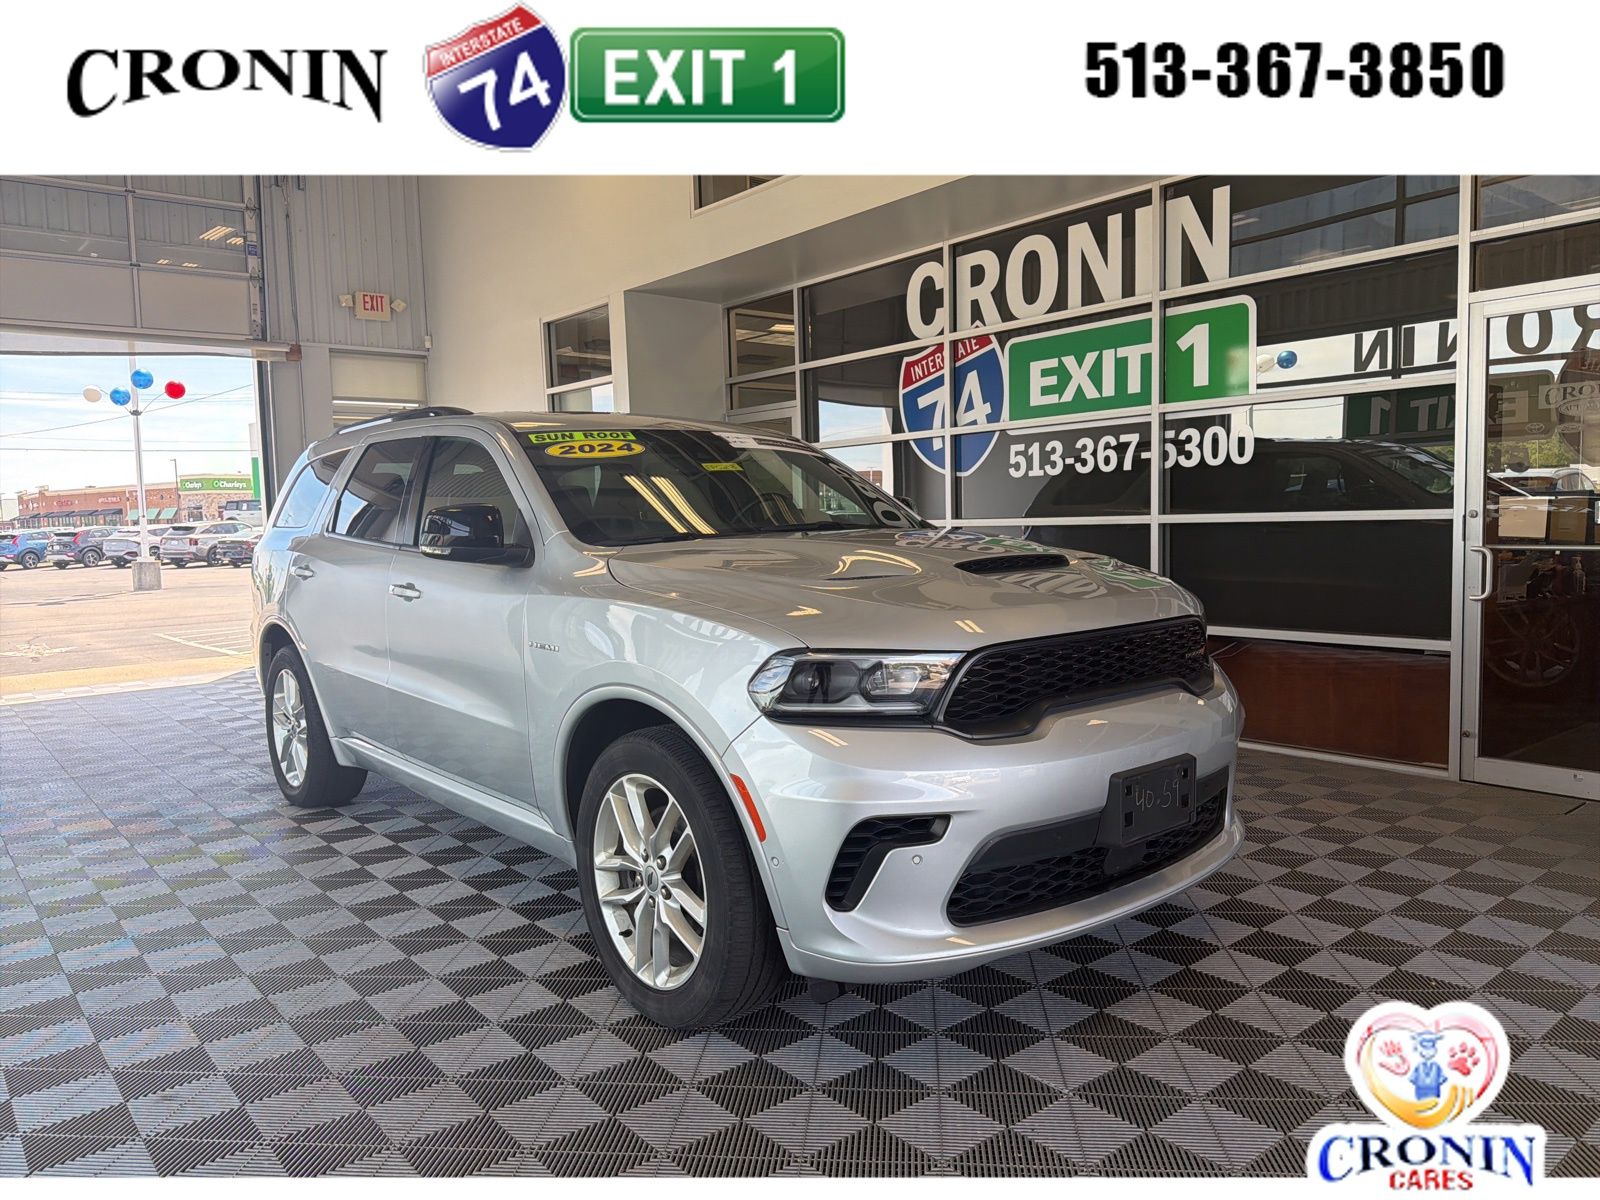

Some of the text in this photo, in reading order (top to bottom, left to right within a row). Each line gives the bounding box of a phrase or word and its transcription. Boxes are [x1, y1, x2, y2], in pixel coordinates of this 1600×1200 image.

[906, 185, 1231, 340] CRONIN
[362, 293, 385, 312] EXIT
[910, 338, 980, 382] INTERATE
[1029, 323, 1210, 406] EXIT 1
[917, 370, 992, 451] 74
[1545, 384, 1600, 406] CRO
[534, 431, 631, 442] SUN ROOF
[559, 442, 635, 456] 2024
[1009, 424, 1255, 478] 513-367-5300
